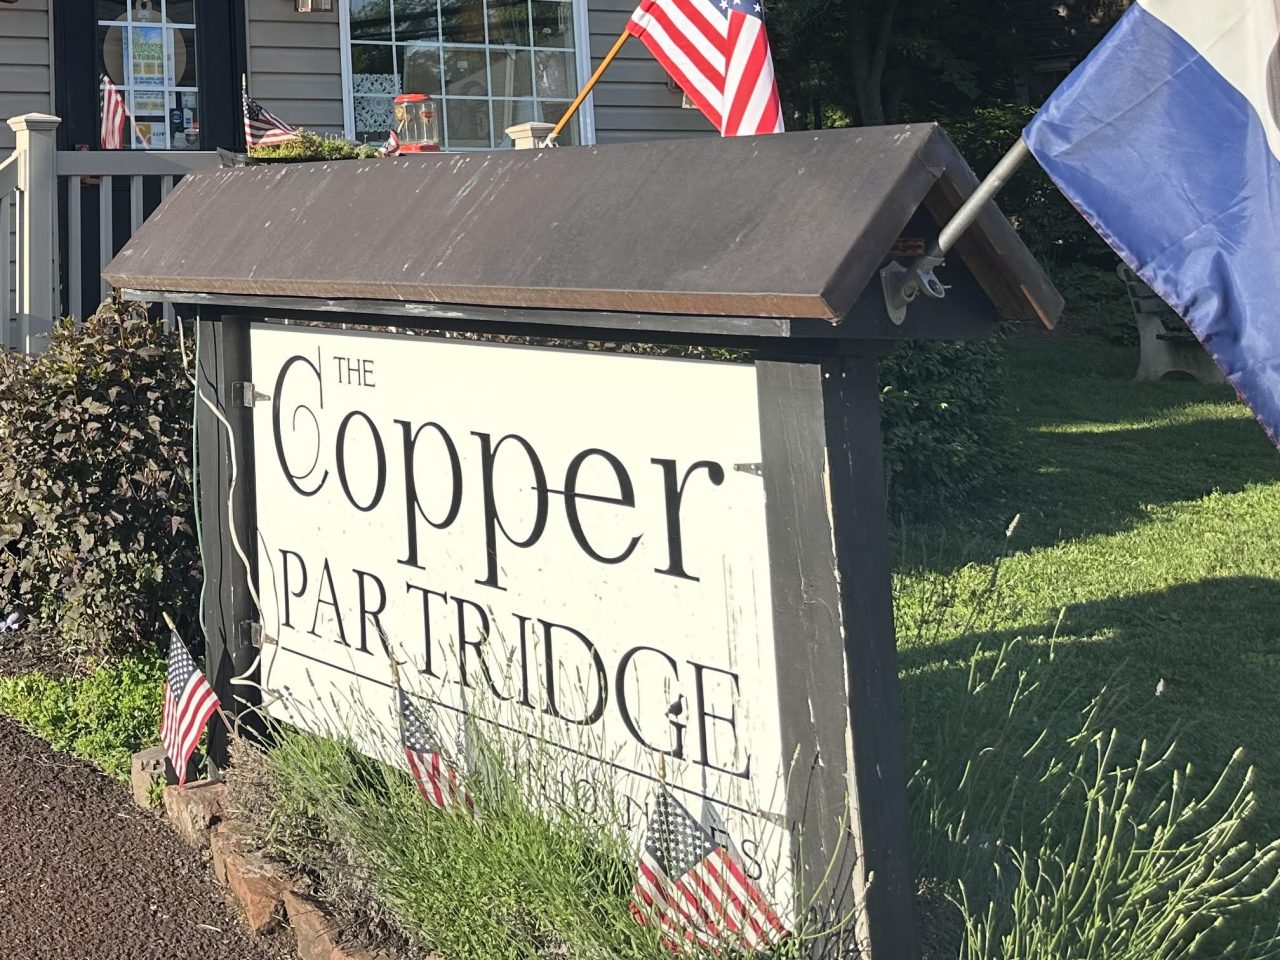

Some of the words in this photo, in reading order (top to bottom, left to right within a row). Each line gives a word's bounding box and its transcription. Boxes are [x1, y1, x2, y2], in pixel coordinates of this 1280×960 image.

[272, 345, 725, 591] Copper
[332, 356, 376, 388] THE
[278, 548, 752, 781] PARTRIDGE
